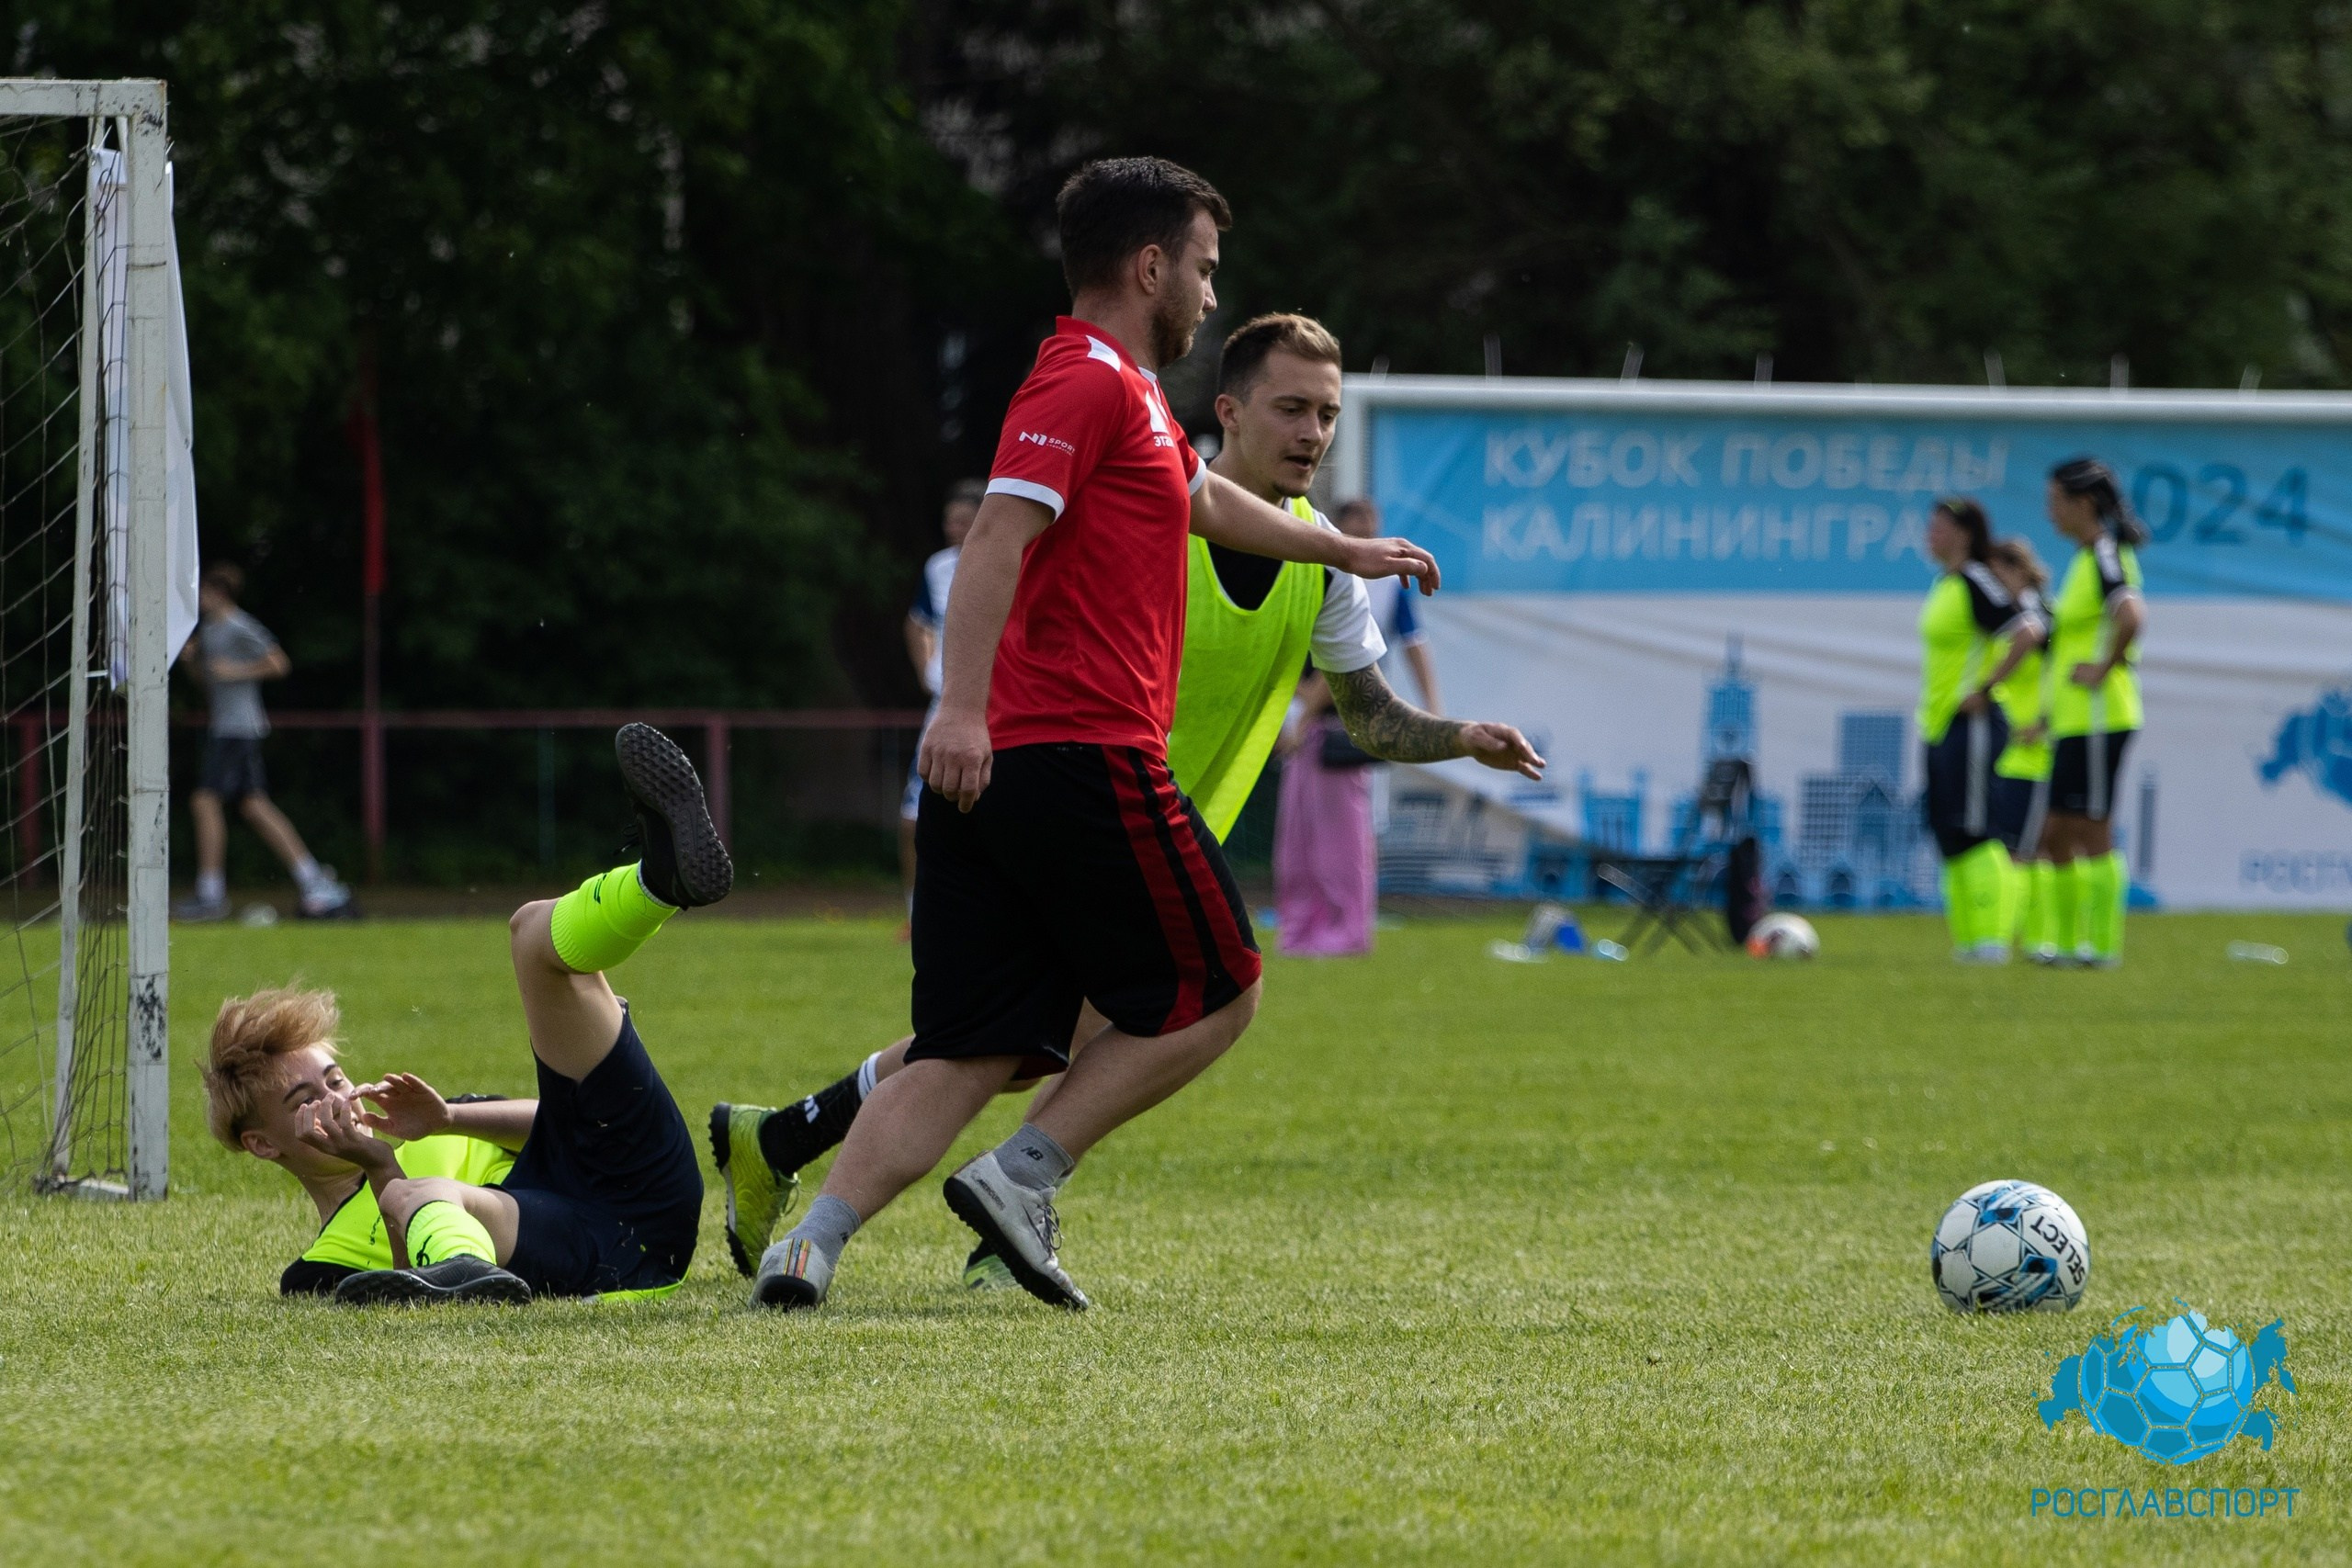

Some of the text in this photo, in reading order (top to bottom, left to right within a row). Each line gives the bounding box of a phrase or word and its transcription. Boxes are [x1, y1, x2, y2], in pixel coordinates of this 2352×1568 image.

[1482, 429, 2010, 496] КУБОК ПОБЕДЫ
[1481, 502, 1933, 564] КАЛИНИНГРА
[2130, 462, 2309, 547] 024
[1020, 1145, 1044, 1161] NB
[2030, 1214, 2086, 1286] SELECT
